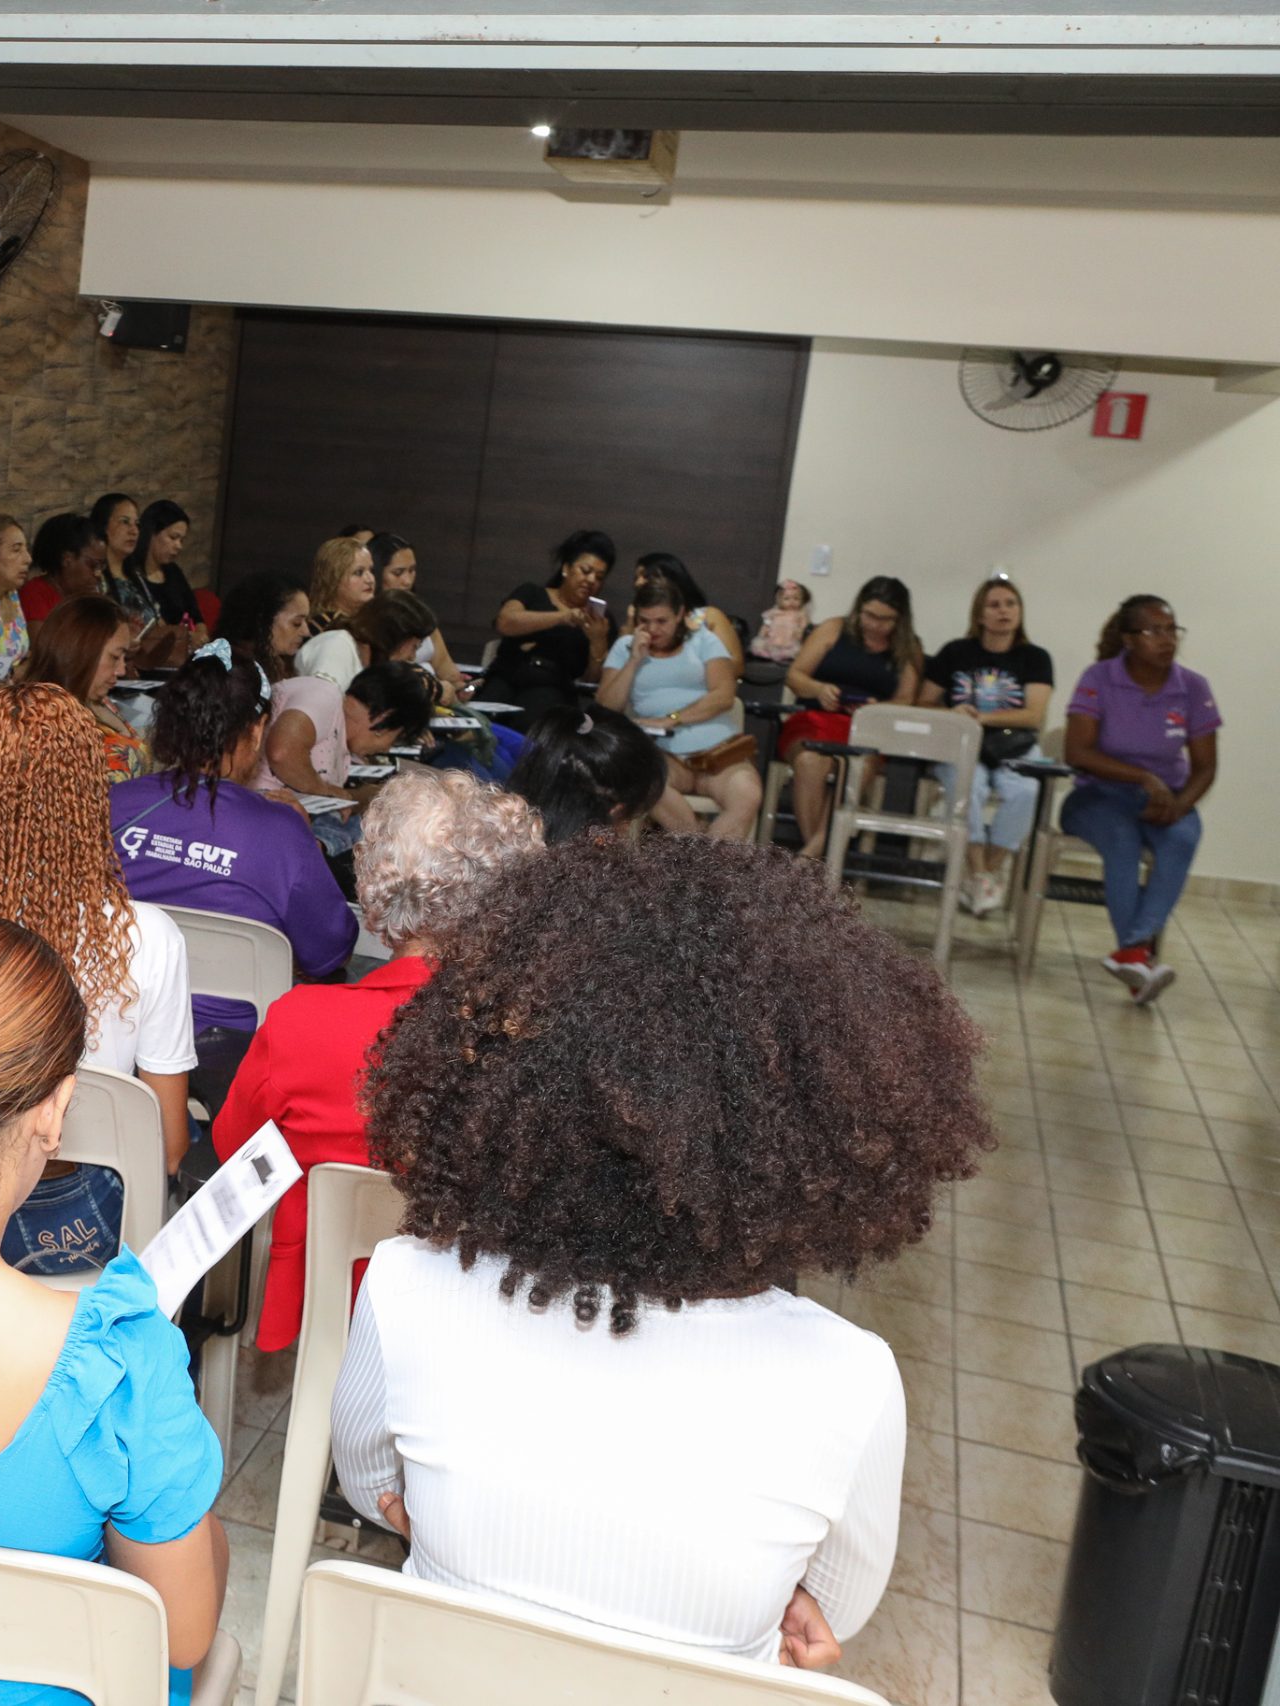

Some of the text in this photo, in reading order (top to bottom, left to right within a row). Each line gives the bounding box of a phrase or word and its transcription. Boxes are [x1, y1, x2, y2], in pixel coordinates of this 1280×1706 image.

[183, 857, 231, 876] SÃO PAULO
[38, 1218, 97, 1254] SAL
